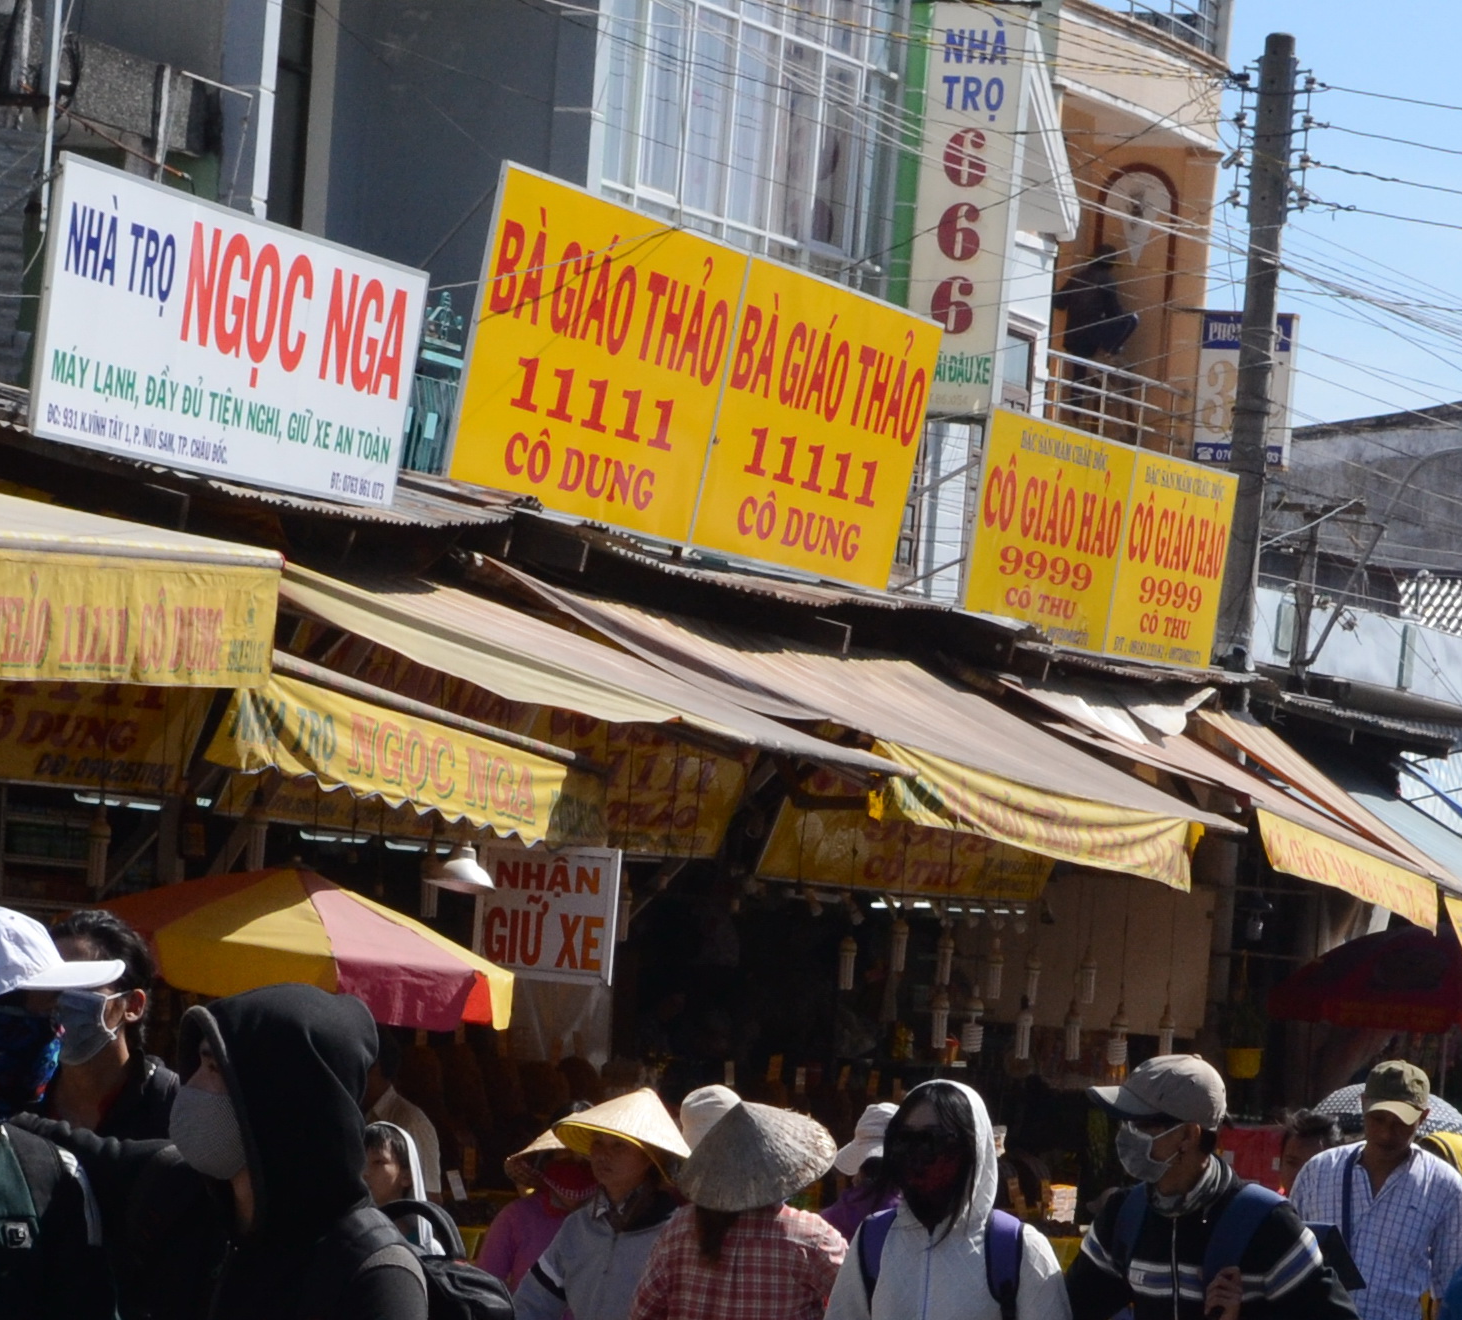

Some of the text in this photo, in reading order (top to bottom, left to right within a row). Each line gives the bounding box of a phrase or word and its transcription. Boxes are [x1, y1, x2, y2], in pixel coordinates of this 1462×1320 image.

[944, 15, 1008, 66] NHÀ
[942, 75, 1005, 122] TRỌ
[64, 195, 409, 401] NHÀ TRỌ NGỌC NGA
[489, 206, 729, 387] BÀ GIÁO THẢO
[51, 345, 392, 465] MÁY LẠNH, ĐẦY ĐỦ TIỆN NGHI, GIỮ XE AN TOÀN
[509, 356, 675, 452] 11111
[729, 292, 927, 448] BÀ GIÁO THẢO
[974, 356, 991, 384] XE
[62, 405, 79, 429] 931
[504, 428, 656, 512] CÔ DUNG
[742, 426, 880, 509] 11111
[983, 453, 1122, 559] CÔ GIÁO HẢO
[736, 489, 862, 563] CÔ DUNG
[1128, 490, 1226, 580] CÔ GIÁO HẢO
[998, 545, 1093, 592] 9999
[1005, 585, 1077, 620] CÔ THU
[1139, 576, 1202, 613] 9999
[58, 604, 129, 672] 11111
[141, 587, 167, 672] CÔ
[168, 606, 224, 674] DUNG
[1140, 609, 1191, 640] CÔ THU
[17, 710, 139, 755] DUNG
[347, 712, 454, 798] NGỌC
[465, 747, 536, 823] NGA
[495, 856, 601, 898] NHẬN
[484, 894, 604, 971] GIỮ XE
